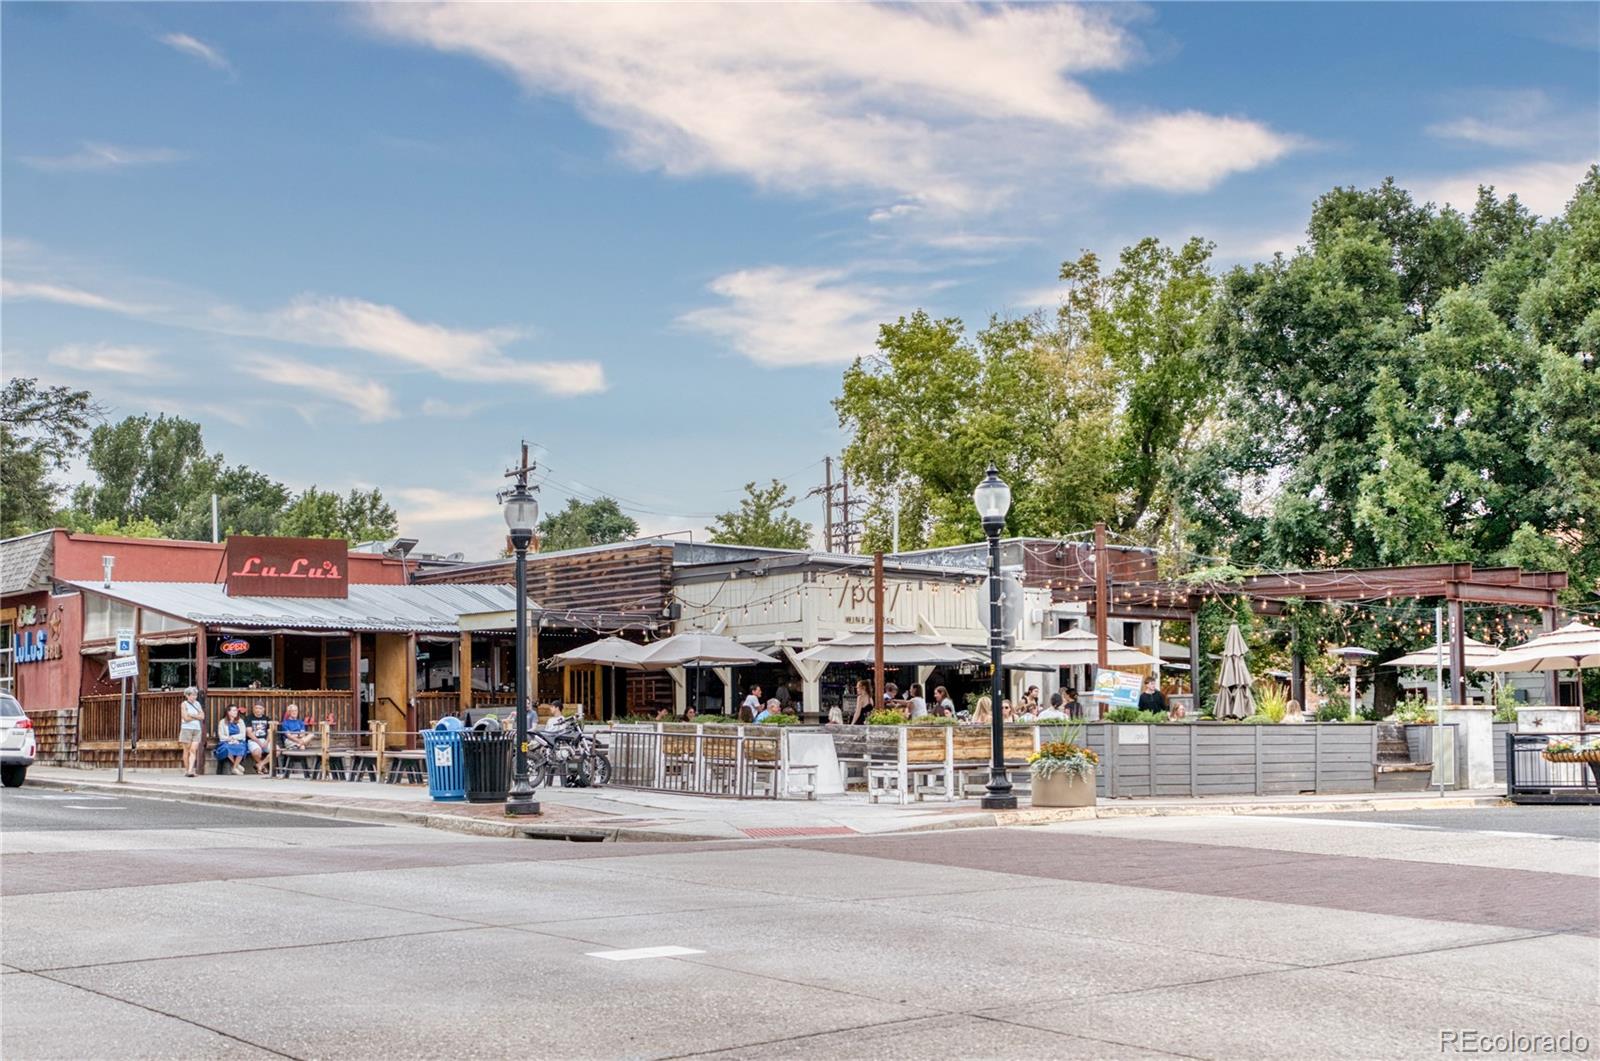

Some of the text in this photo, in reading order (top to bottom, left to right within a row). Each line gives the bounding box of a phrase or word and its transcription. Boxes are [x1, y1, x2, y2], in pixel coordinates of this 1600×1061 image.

[845, 616, 894, 625] WINE HSE
[222, 640, 247, 652] OPEN
